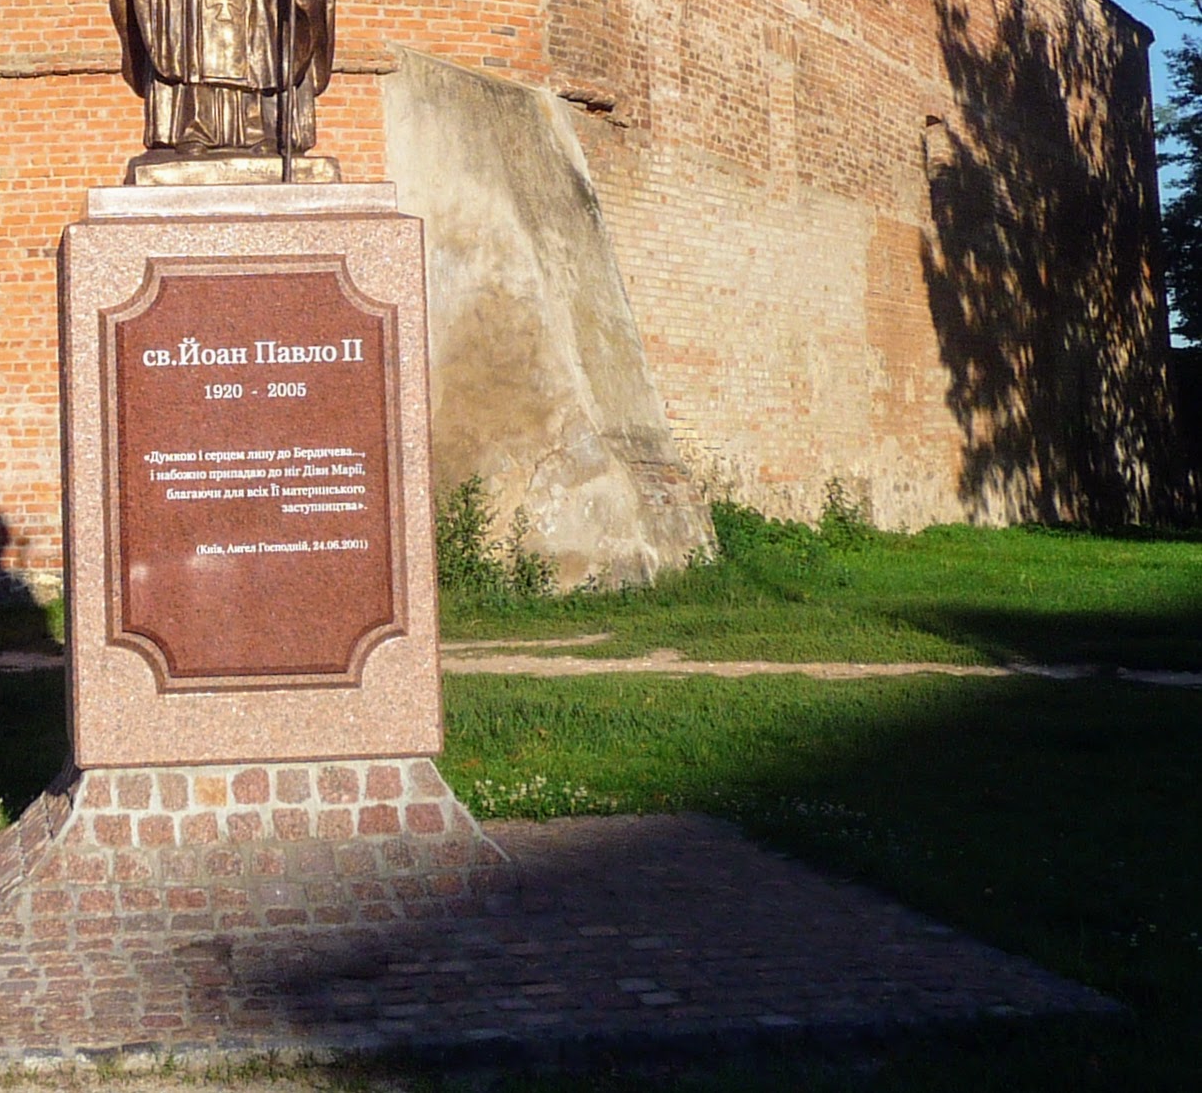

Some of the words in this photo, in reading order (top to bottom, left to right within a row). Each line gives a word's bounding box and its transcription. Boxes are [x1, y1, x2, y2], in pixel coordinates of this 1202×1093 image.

[142, 336, 248, 367] св.Йоан
[254, 340, 338, 365] Павло
[204, 383, 243, 400] 1920
[267, 382, 307, 398] 2005
[204, 450, 245, 463] серцем
[246, 450, 276, 462] лину
[277, 449, 291, 460] до
[156, 469, 207, 481] набожно
[209, 469, 267, 482] припадаю
[267, 467, 283, 479] до
[284, 465, 302, 477] ніг
[302, 464, 329, 478] Діви
[331, 463, 366, 478] Марії,
[166, 487, 222, 500] благаючи
[223, 488, 245, 500] для
[246, 485, 269, 498] всіх
[282, 484, 366, 499] материнського
[196, 544, 226, 556] (Київ,
[258, 540, 311, 553] Господній,
[313, 539, 369, 552] 24.06.2001)
